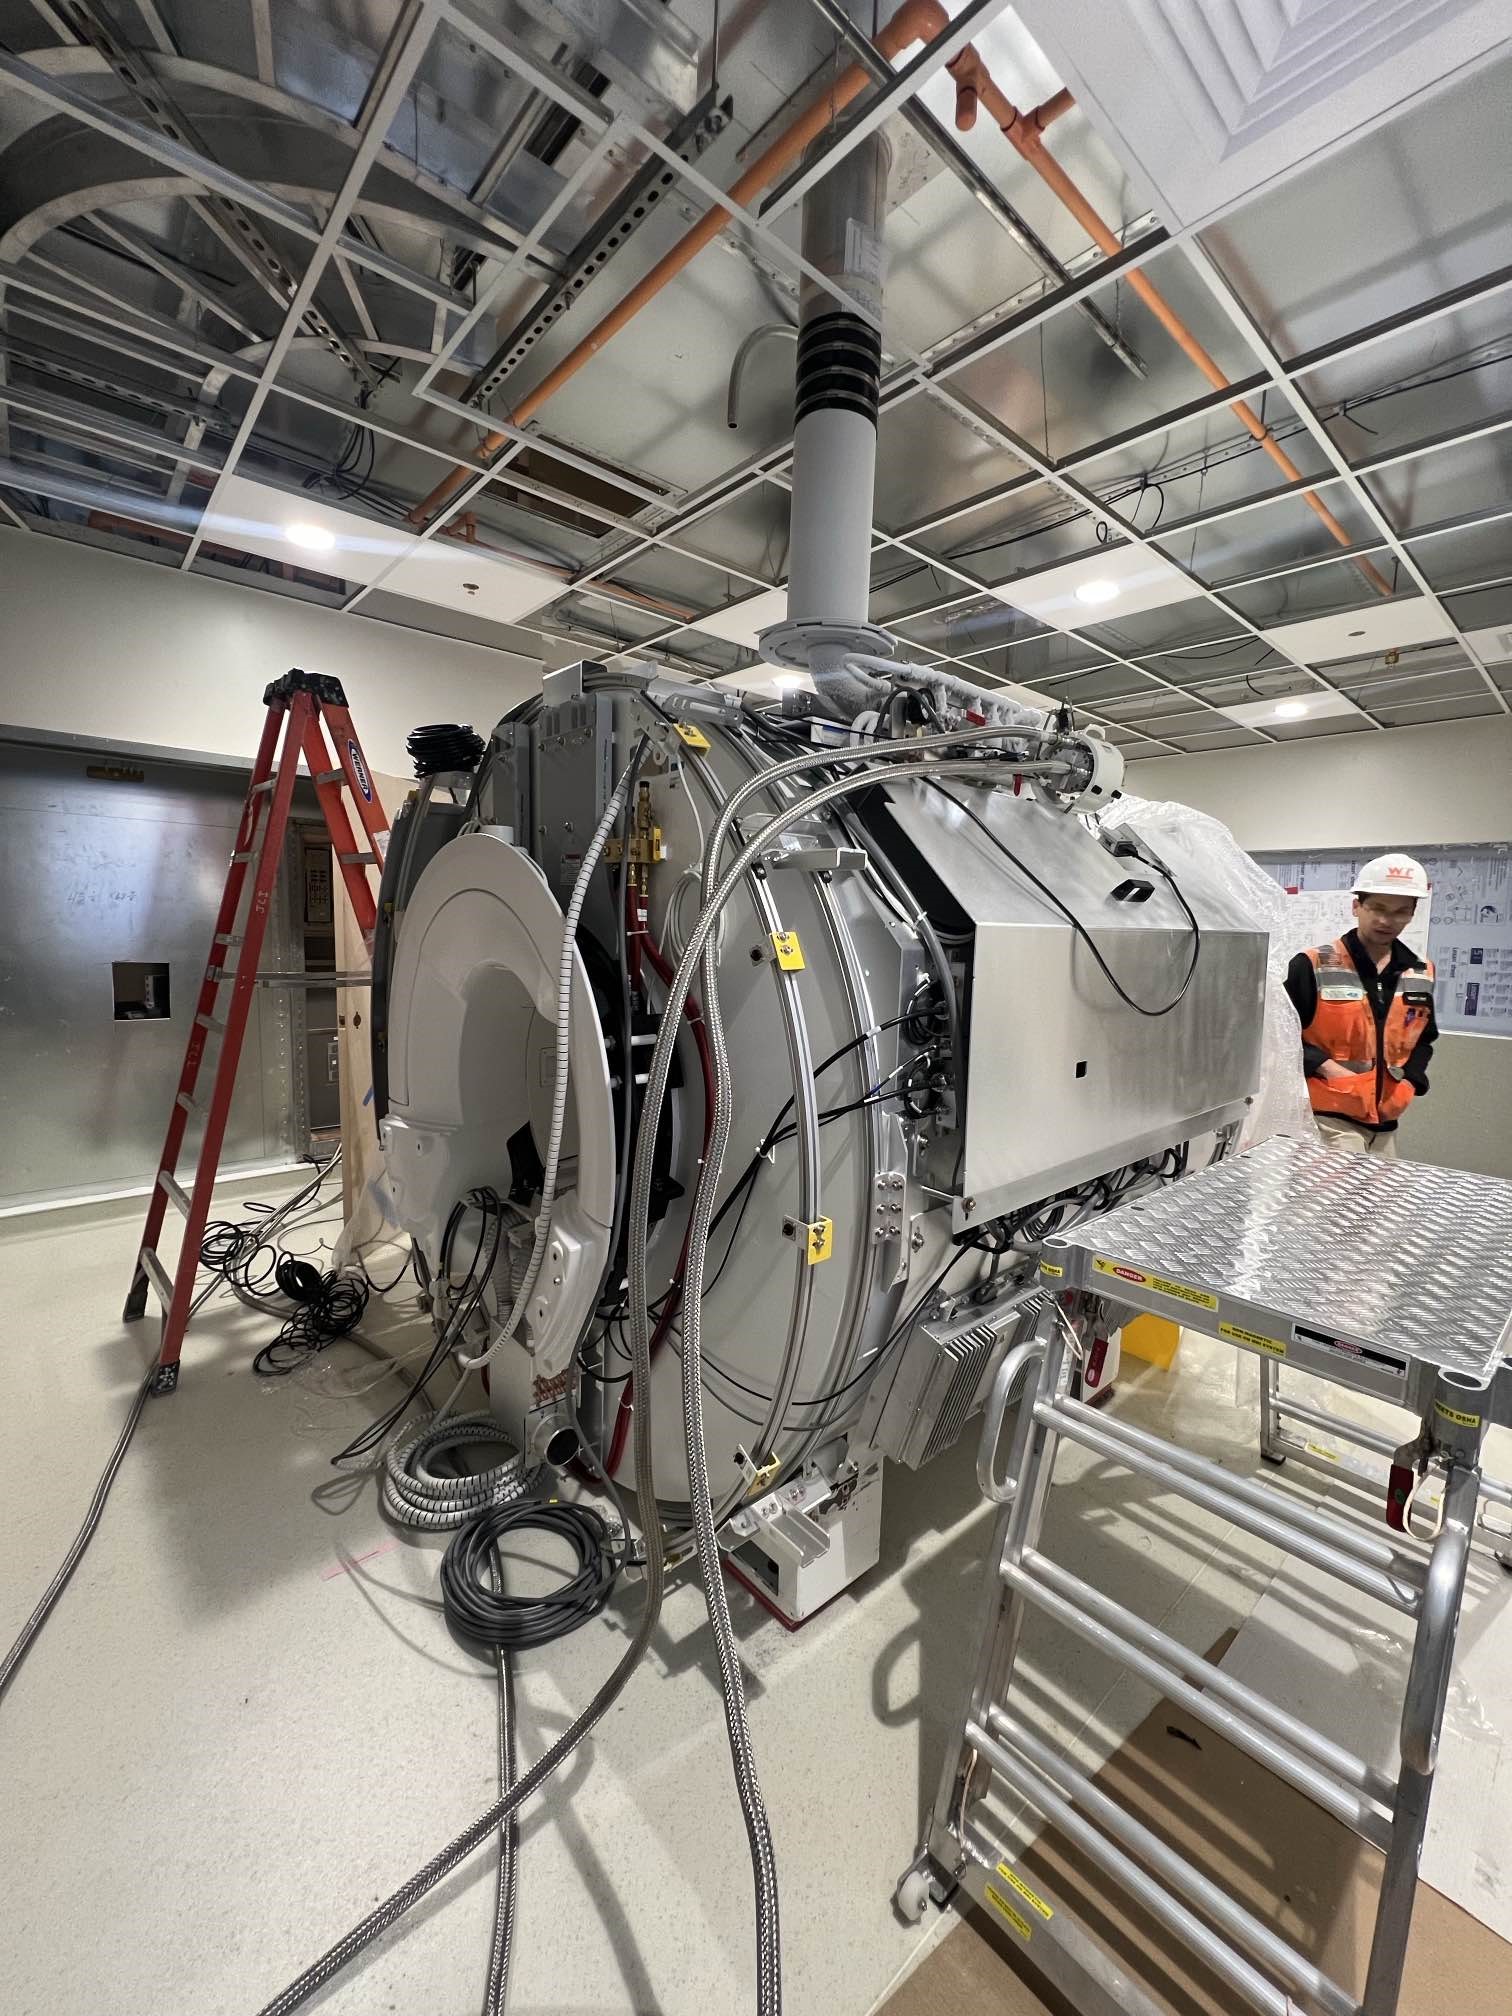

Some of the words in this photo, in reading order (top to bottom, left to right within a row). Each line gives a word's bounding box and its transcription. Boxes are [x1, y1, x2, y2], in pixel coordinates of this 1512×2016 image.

[352, 753, 368, 790] WERNER
[1115, 1268, 1143, 1282] DANGER
[1455, 1413, 1476, 1424] OSHA
